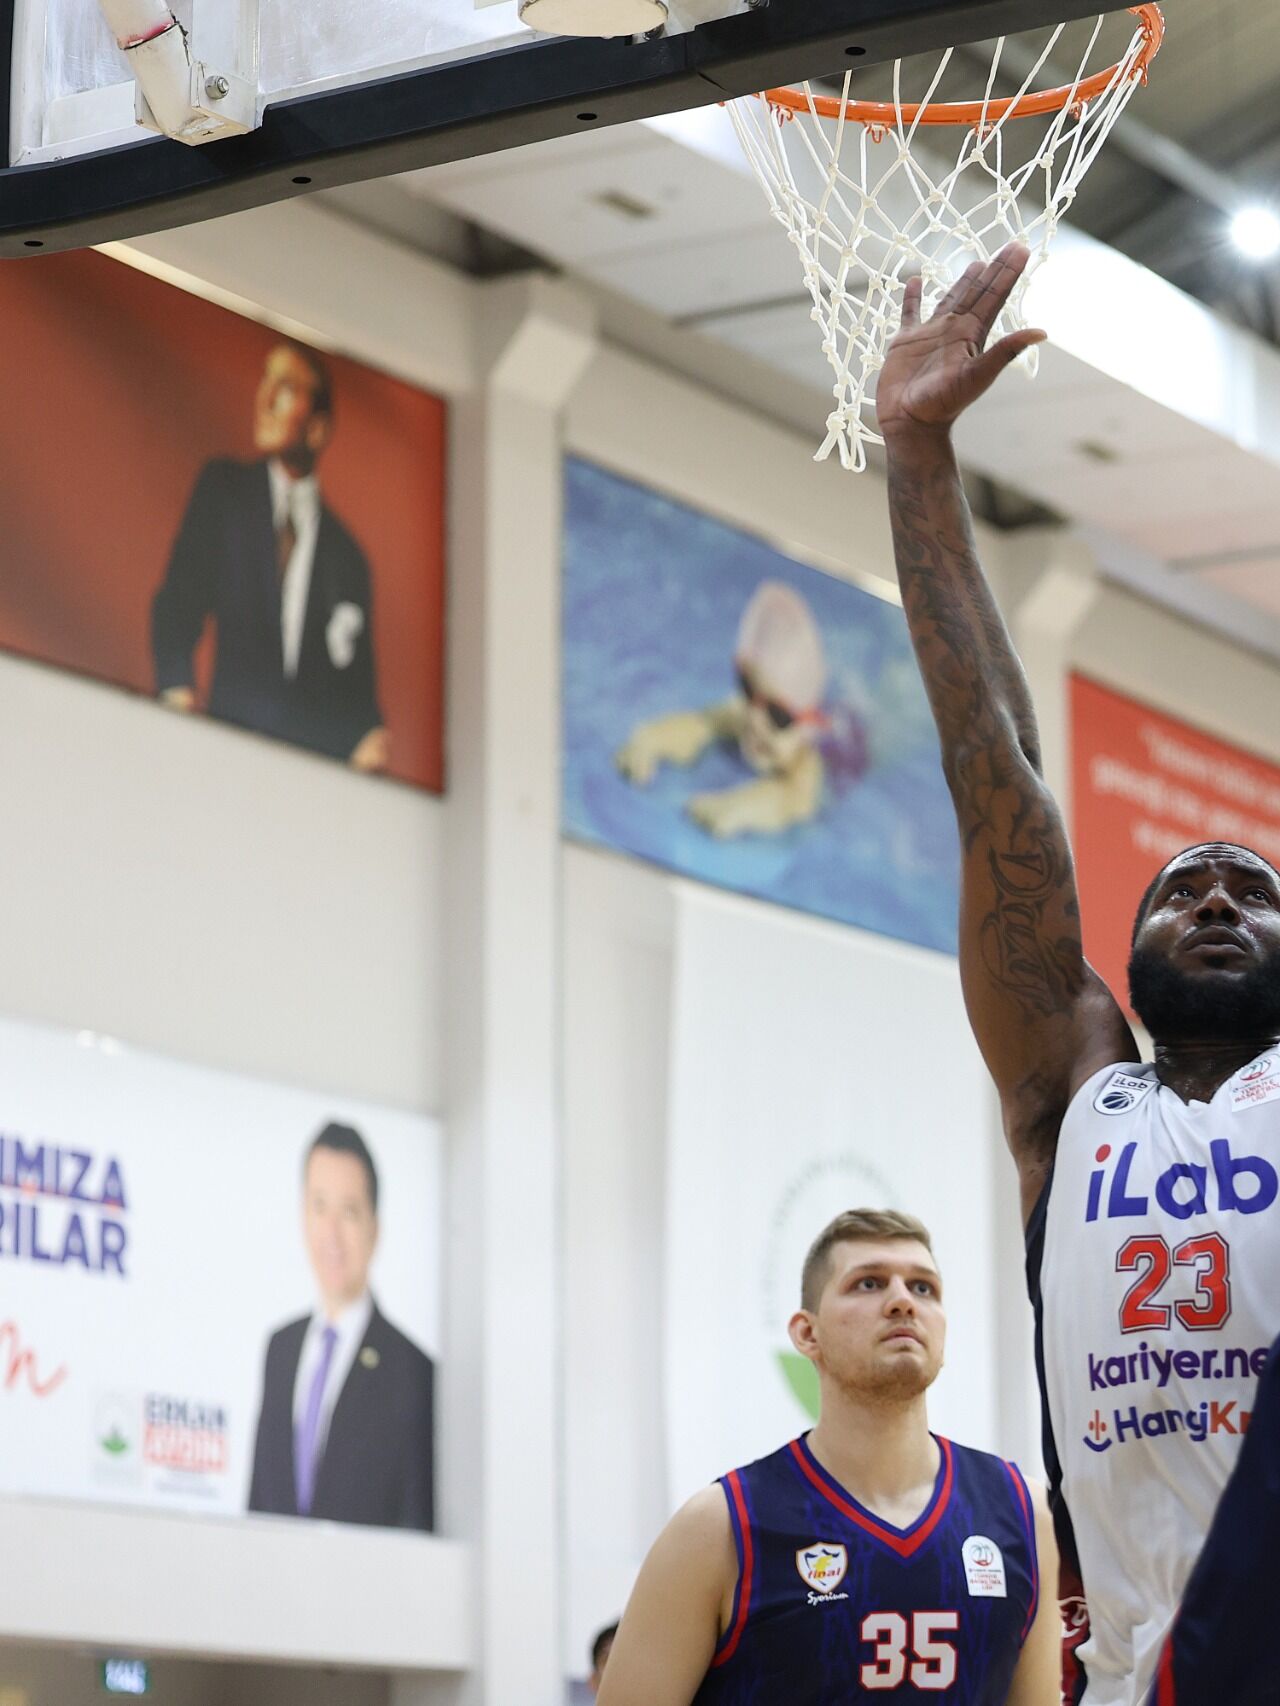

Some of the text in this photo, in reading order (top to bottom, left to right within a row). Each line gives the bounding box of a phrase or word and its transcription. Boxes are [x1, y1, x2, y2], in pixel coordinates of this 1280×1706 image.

[1114, 1076, 1148, 1089] iLab
[1085, 1138, 1279, 1223] iLab
[0, 1197, 126, 1275] ILAR
[1115, 1231, 1231, 1334] 23
[1088, 1341, 1268, 1392] kariyer.ne
[859, 1609, 959, 1691] 35
